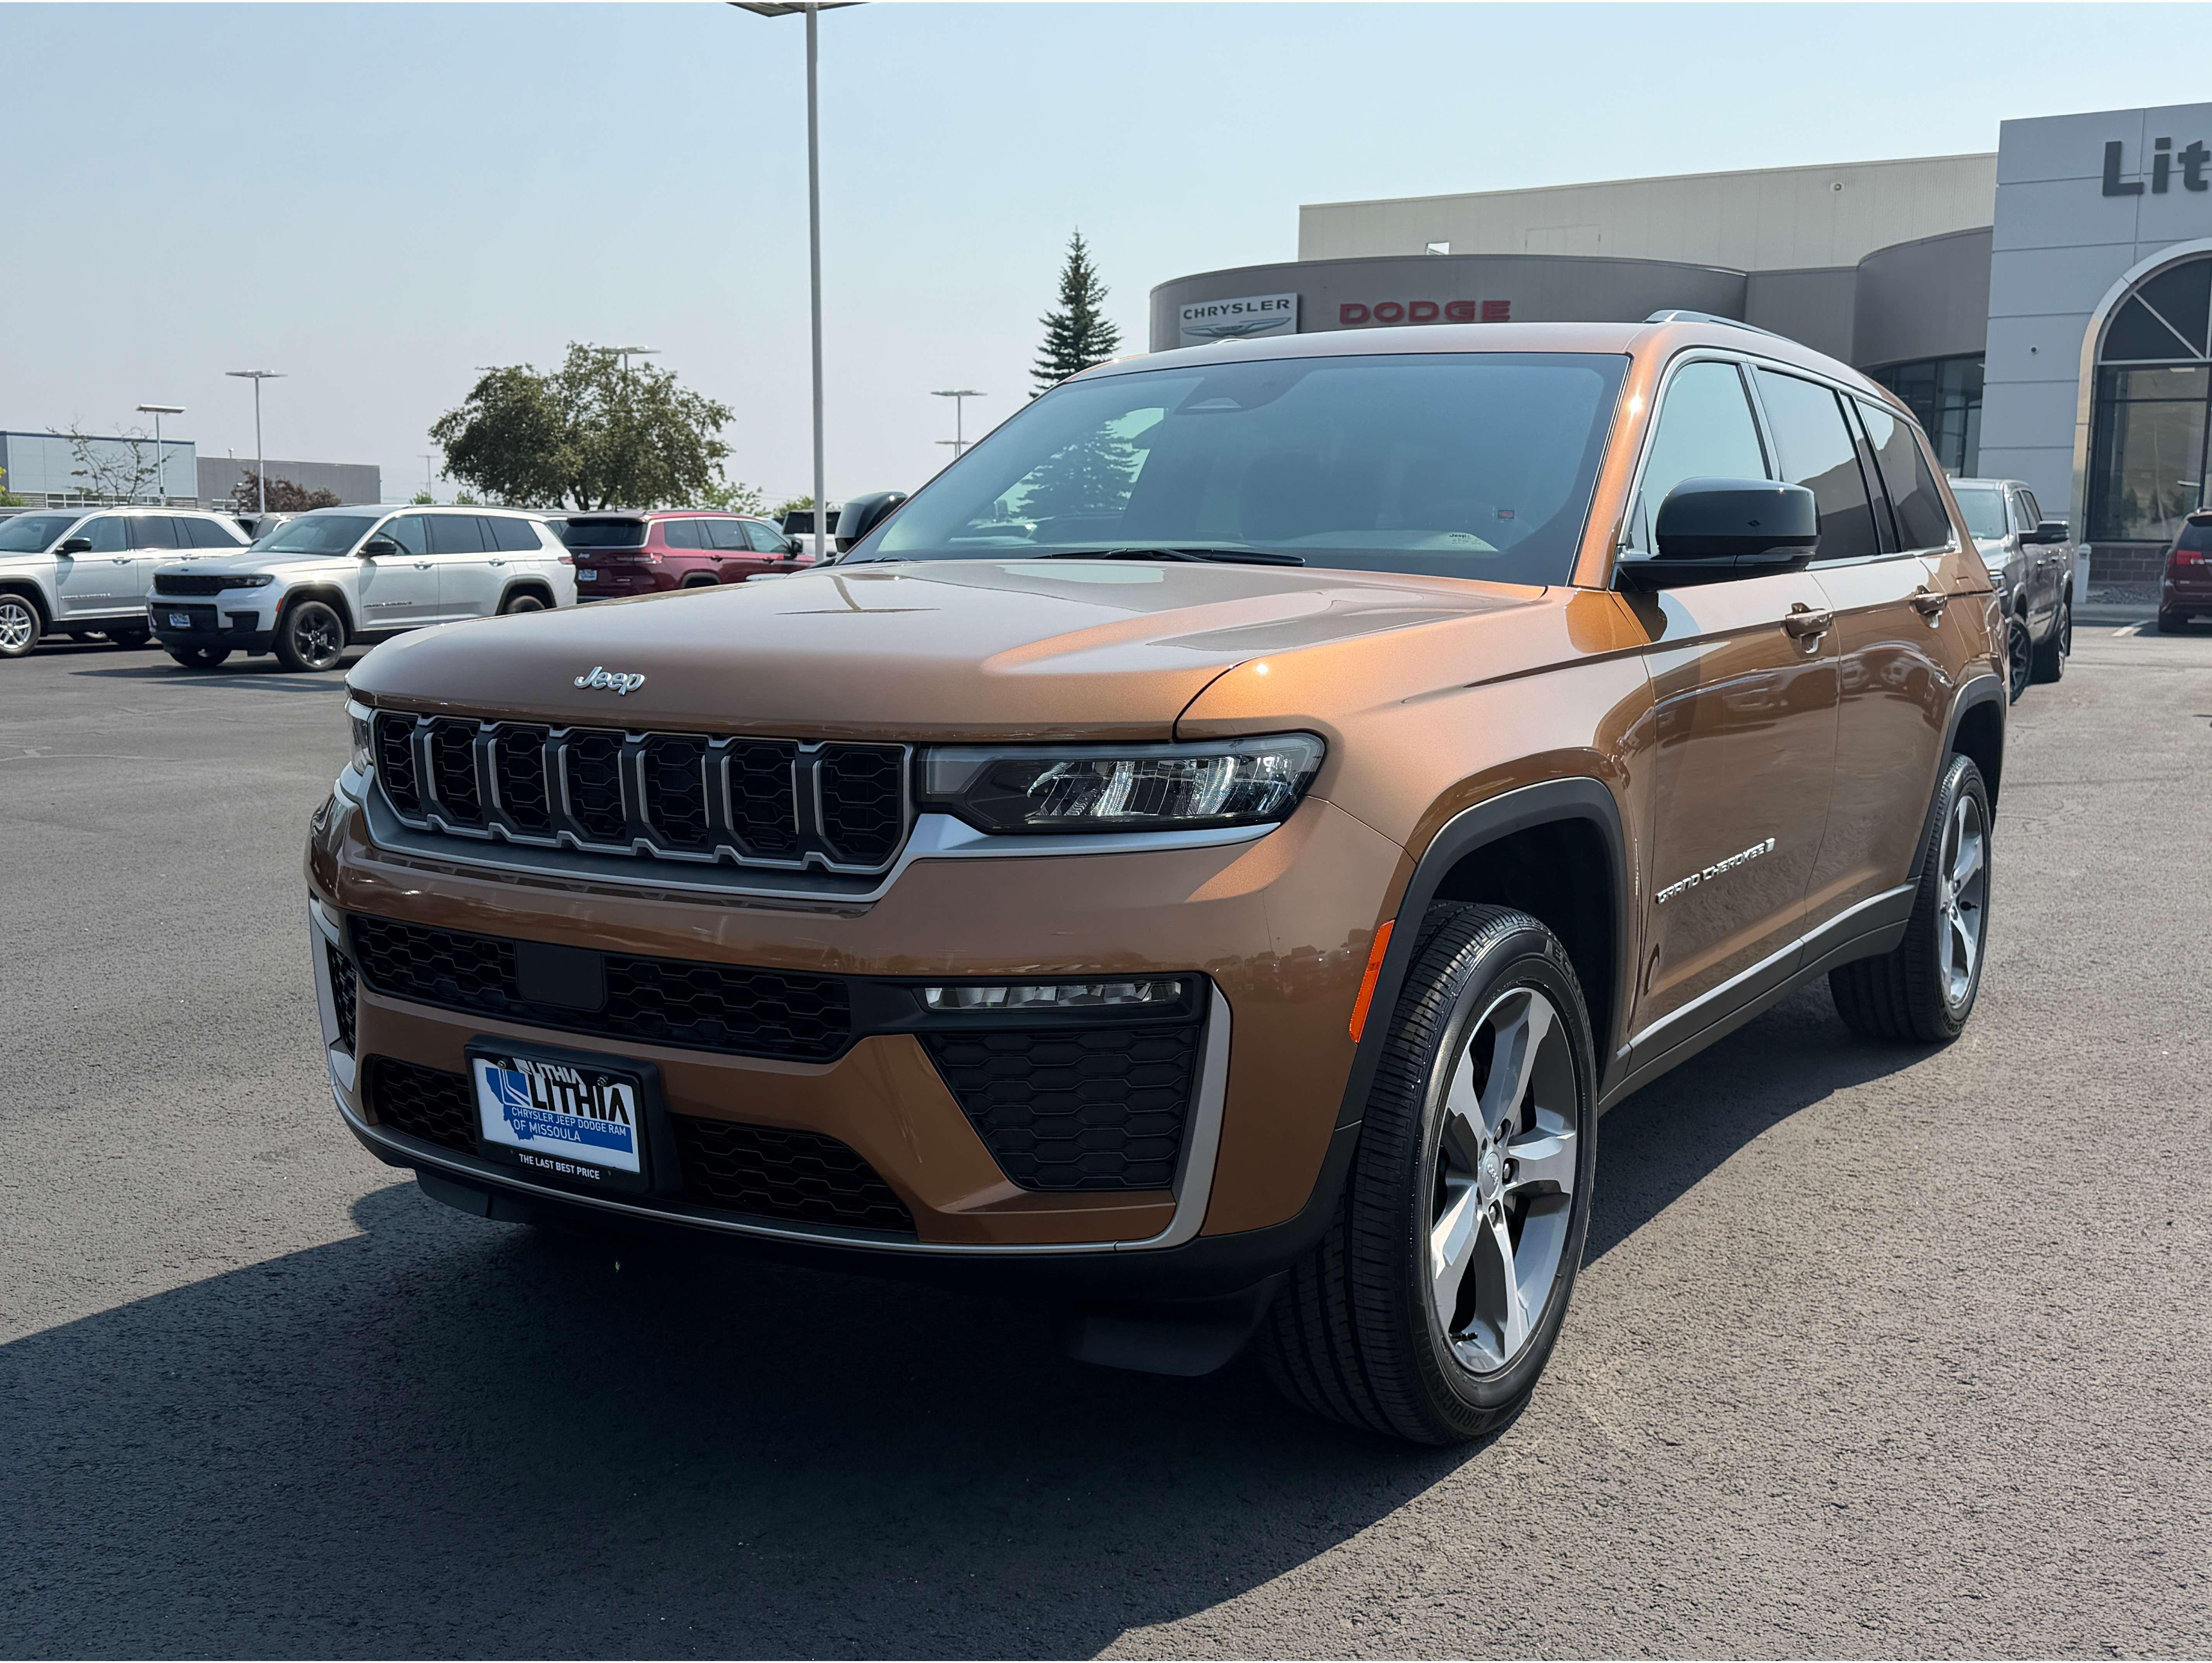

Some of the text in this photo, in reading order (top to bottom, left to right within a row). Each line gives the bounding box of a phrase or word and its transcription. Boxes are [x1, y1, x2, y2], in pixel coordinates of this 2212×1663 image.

[2102, 137, 2210, 197] Lit
[1183, 299, 1290, 319] CHRYSLER
[1339, 300, 1510, 324] DODGE
[574, 666, 645, 695] Jeep
[1656, 873, 1700, 904] GRAND
[1702, 842, 1765, 880] CHEROKEE
[527, 1061, 586, 1085] LITHIA
[528, 1074, 630, 1125] LITHIA
[512, 1107, 626, 1136] CHRYSLER JEEP DODGE RAM
[514, 1119, 581, 1142] OF MISSOULA
[519, 1153, 600, 1180] THE LAST BEST PRICE
